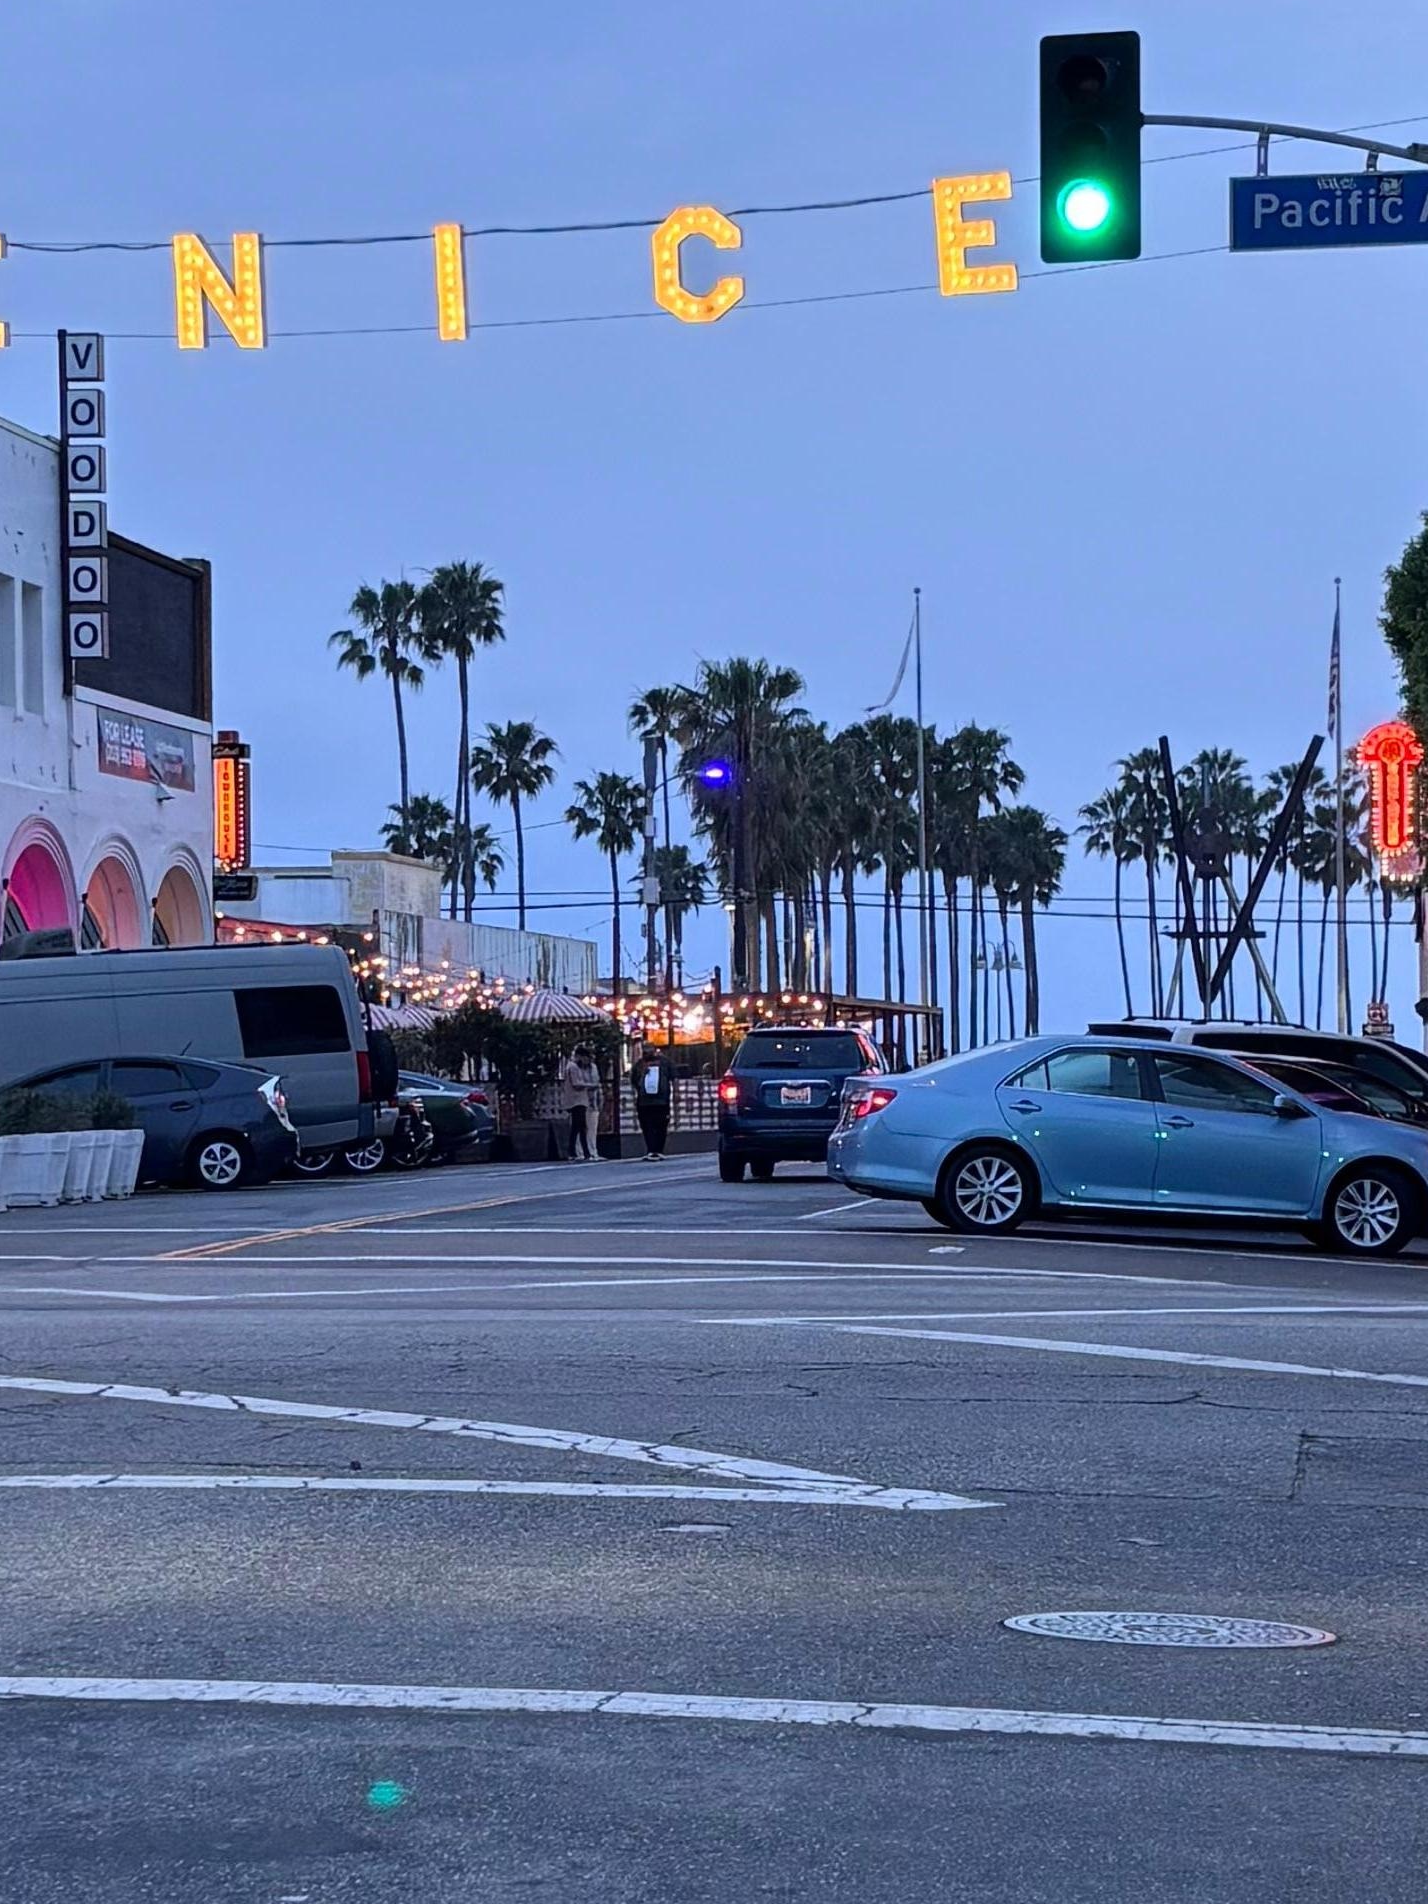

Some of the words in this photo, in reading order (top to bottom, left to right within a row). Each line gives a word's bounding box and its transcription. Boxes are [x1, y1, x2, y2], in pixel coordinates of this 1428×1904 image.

[1253, 188, 1404, 229] Pacific
[71, 343, 99, 650] VOODOO
[104, 719, 120, 742] FOR
[120, 722, 146, 749] LEASE
